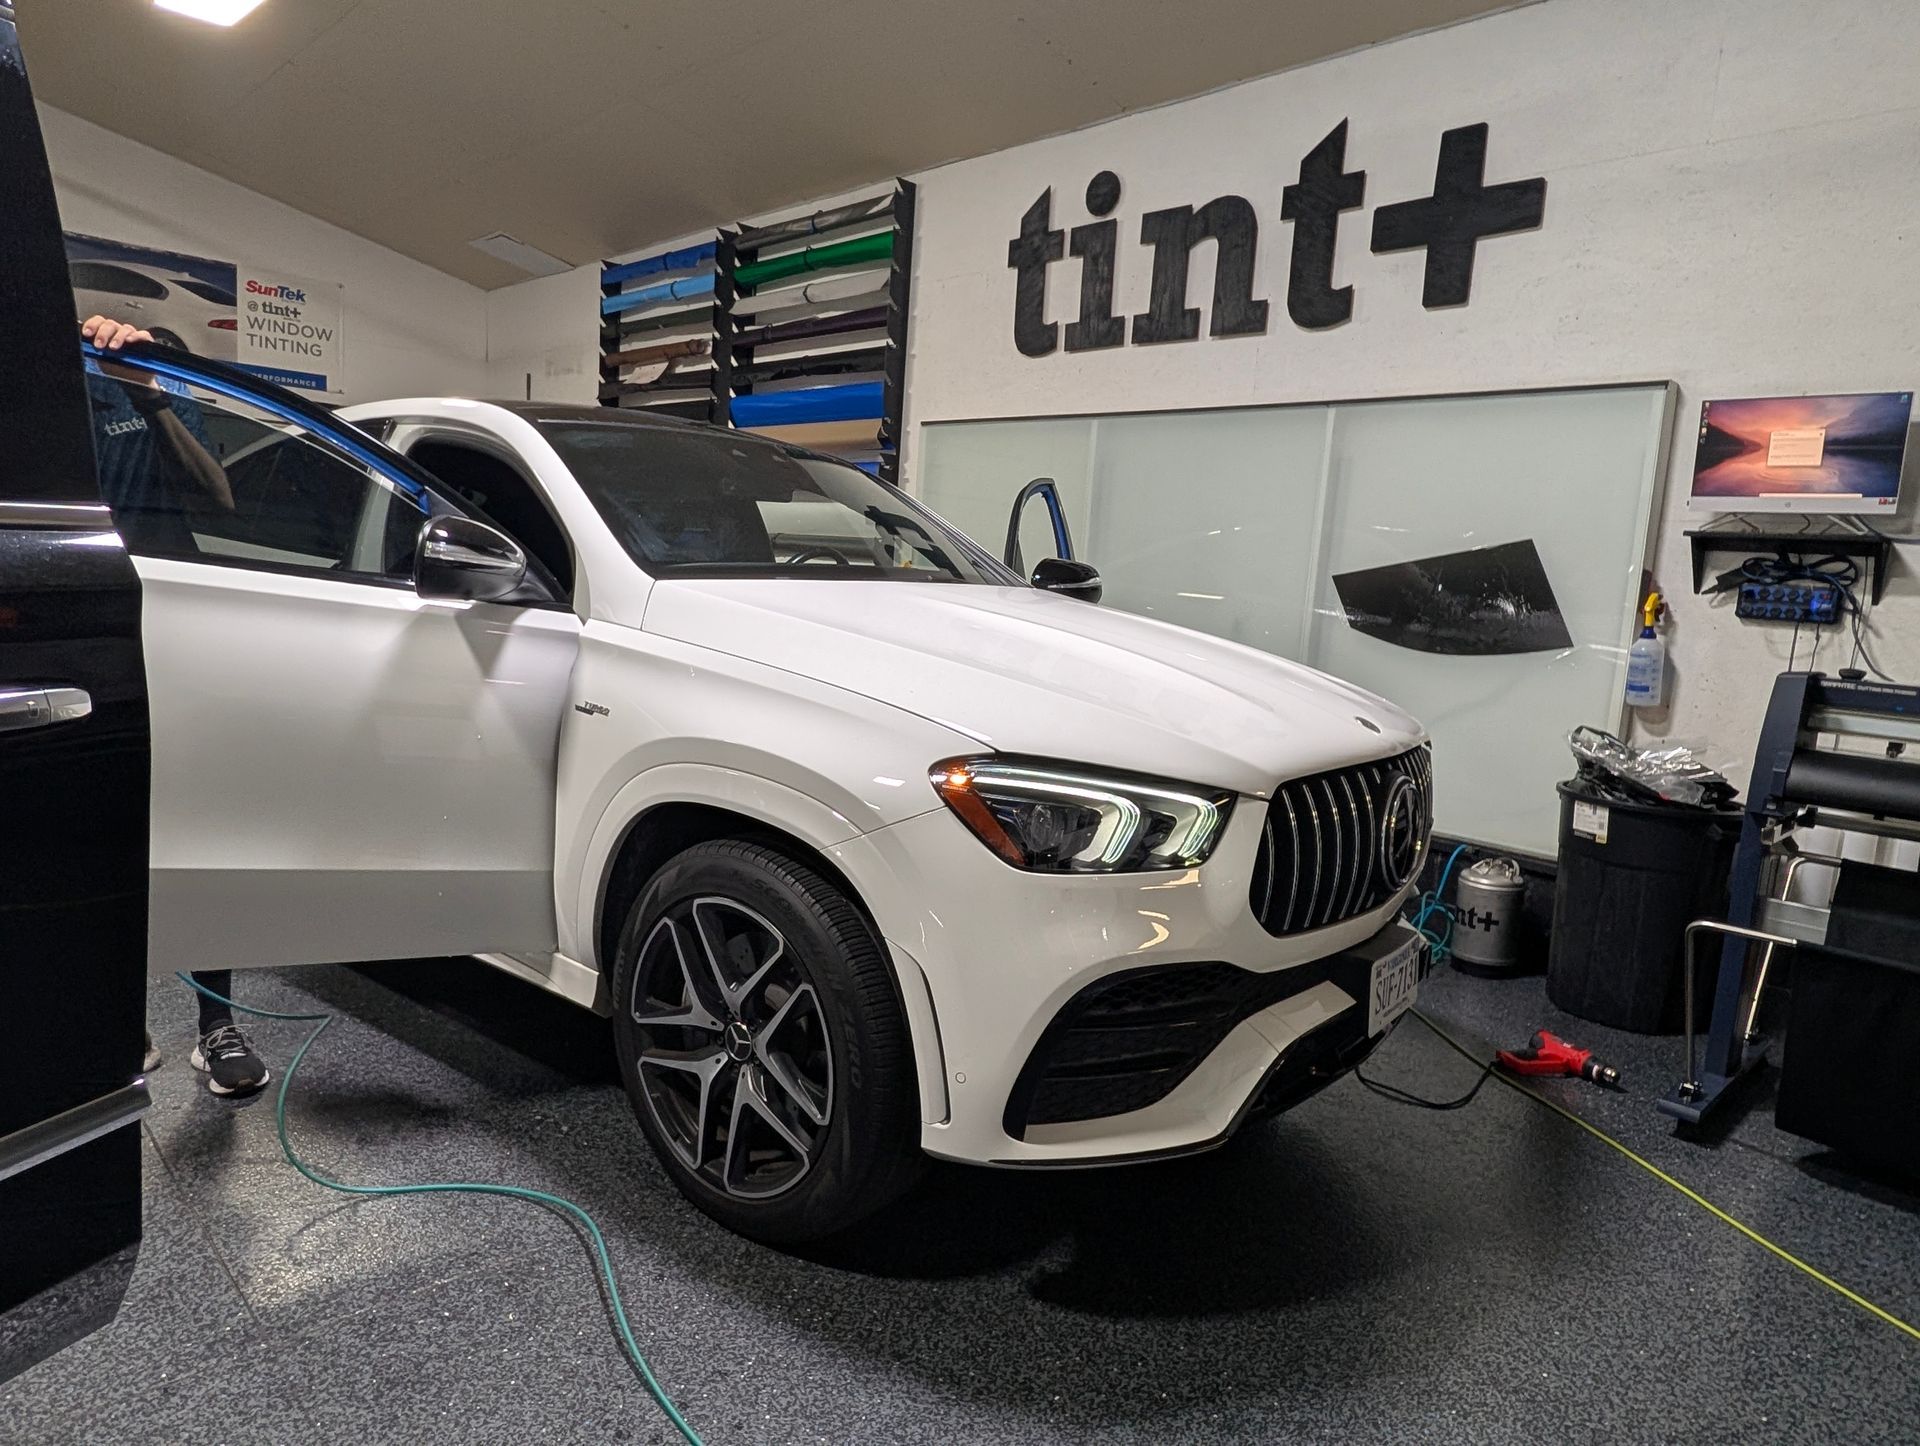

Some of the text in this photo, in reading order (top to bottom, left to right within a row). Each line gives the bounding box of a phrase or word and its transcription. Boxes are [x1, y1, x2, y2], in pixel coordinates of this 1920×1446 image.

[1008, 116, 1547, 358] tint+
[246, 280, 306, 303] SunTek
[247, 301, 302, 318] @ tint+
[246, 315, 333, 341] WINDOW
[246, 333, 322, 357] TINTING
